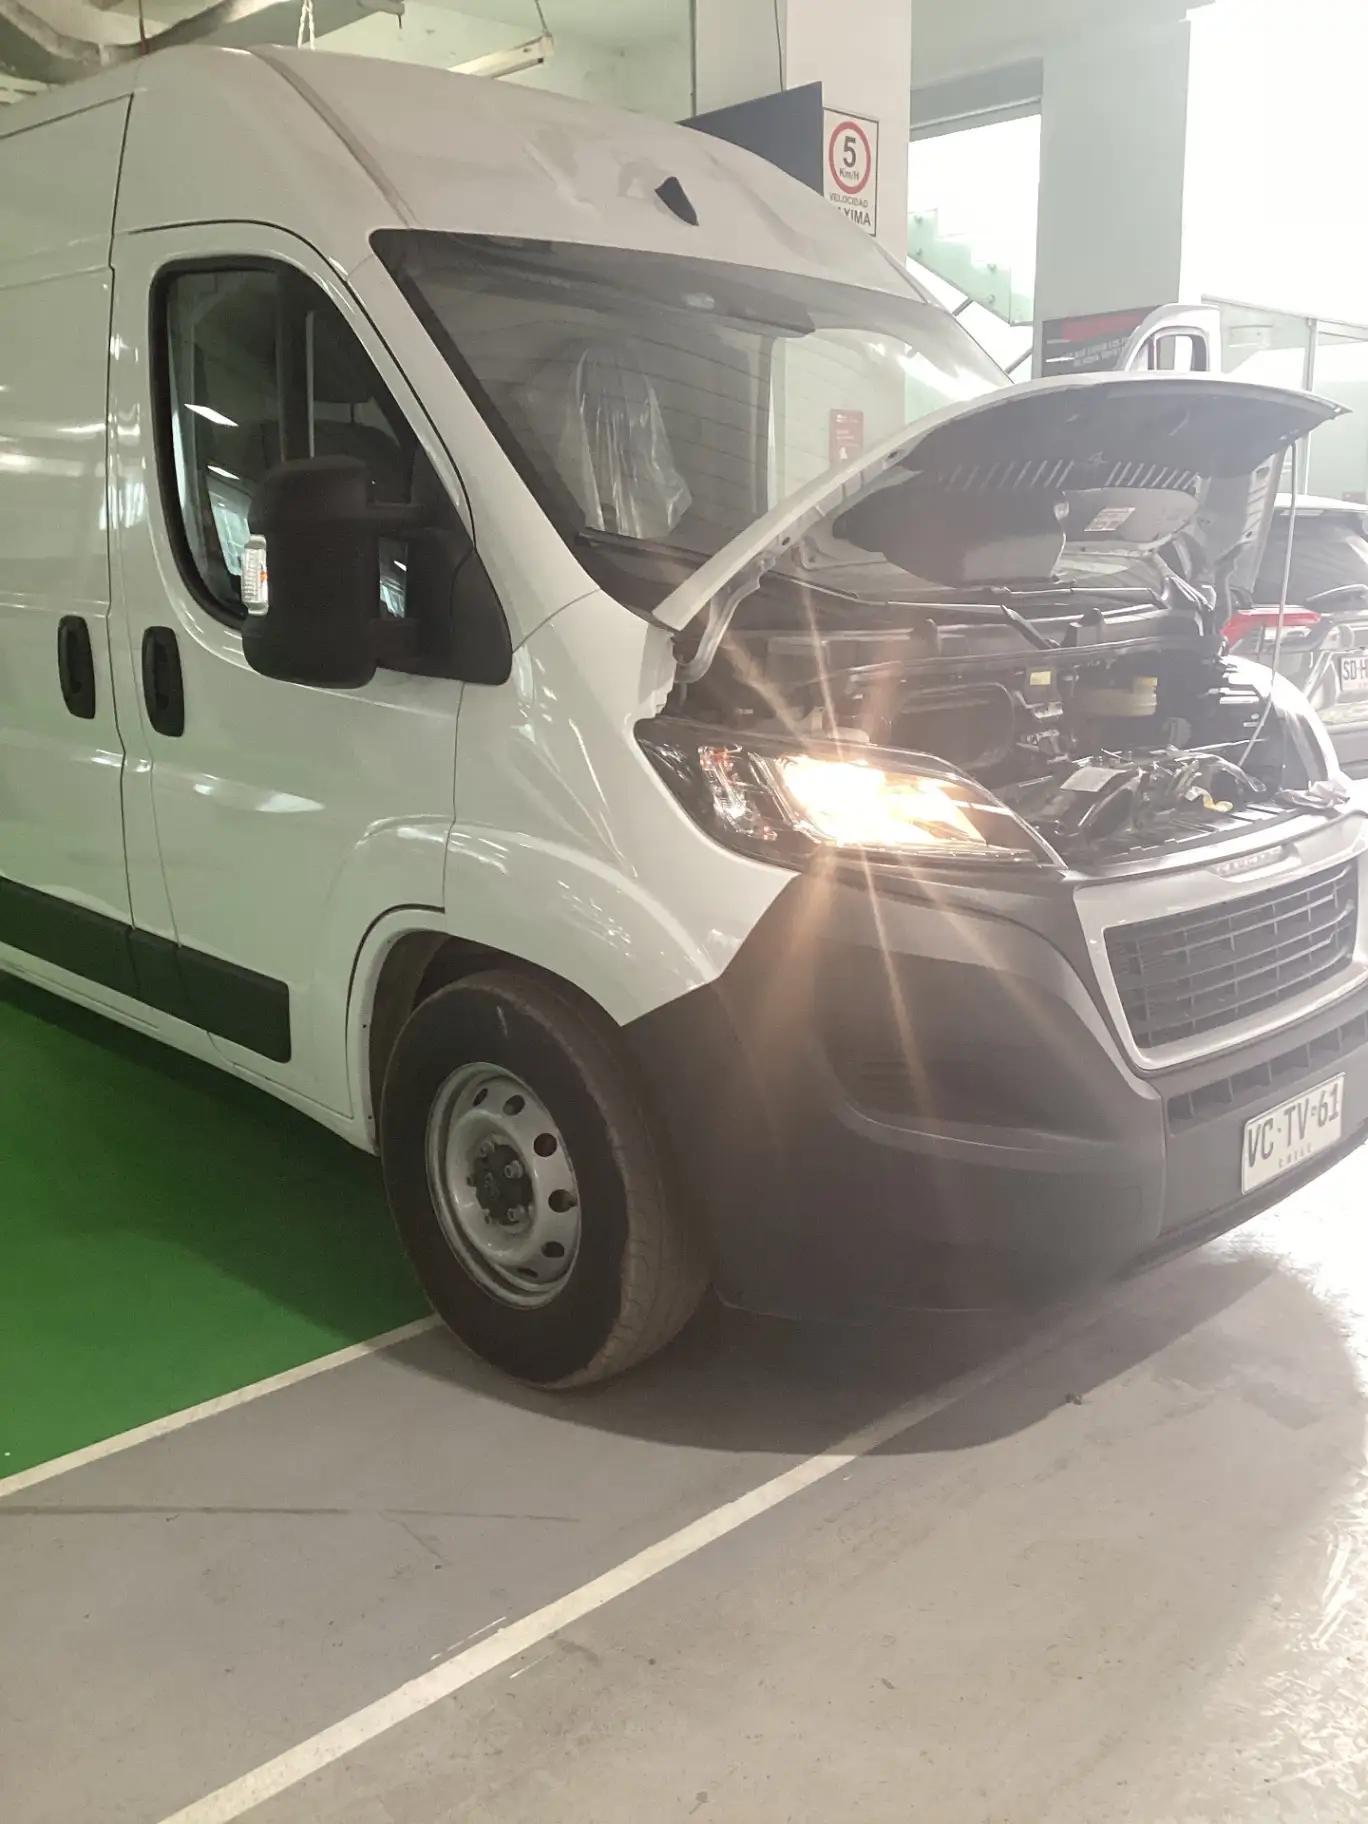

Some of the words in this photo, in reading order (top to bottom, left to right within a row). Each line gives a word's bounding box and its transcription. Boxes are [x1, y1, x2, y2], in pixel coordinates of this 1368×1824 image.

[843, 135, 856, 168] 5
[840, 168, 859, 181] Km/H
[830, 192, 869, 208] VELOCIDAD
